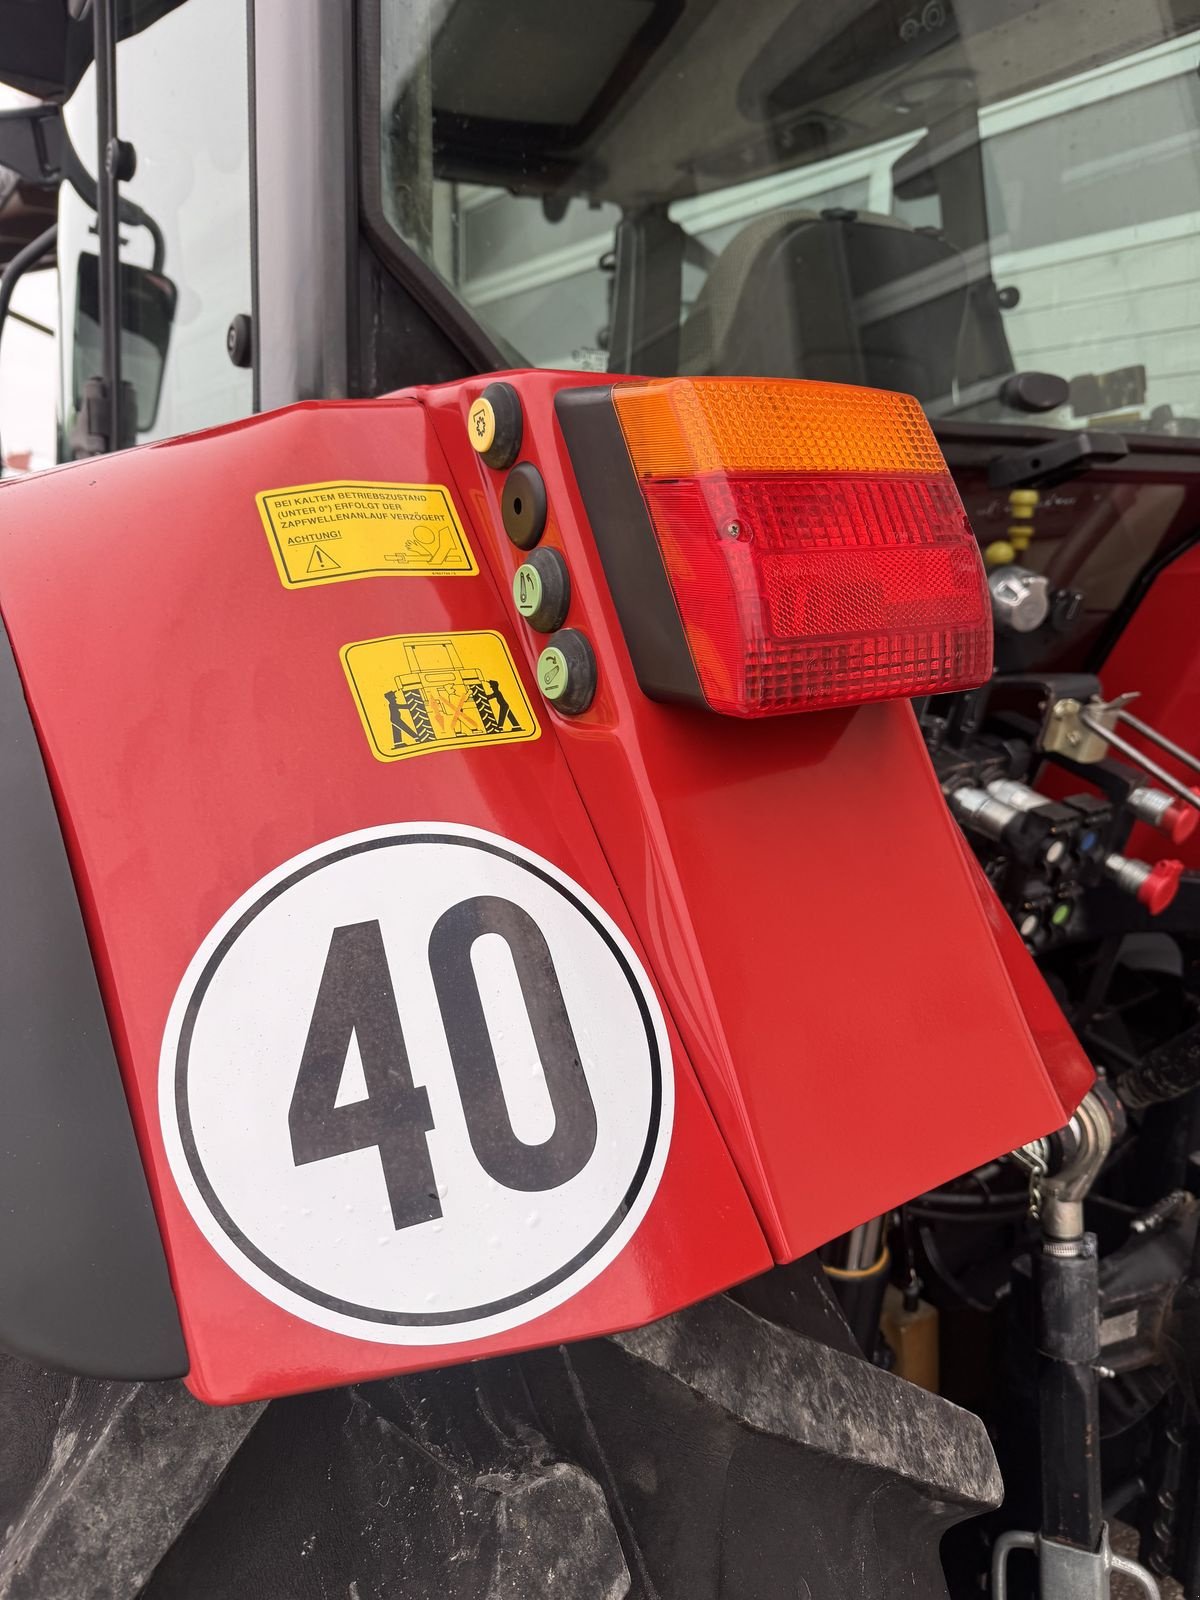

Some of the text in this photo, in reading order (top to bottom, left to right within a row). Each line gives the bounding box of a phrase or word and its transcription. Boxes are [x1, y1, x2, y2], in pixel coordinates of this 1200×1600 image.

[274, 491, 427, 509] BEI KALTEM BETRIEBSZUSTAND
[277, 507, 318, 519] (UNTER
[334, 502, 380, 512] ERFOLGT
[382, 502, 402, 511] DER
[281, 512, 445, 529] ZAPFWELLENANLAUF VERZÖGERT
[287, 530, 342, 544] ACHTUNG!
[288, 895, 598, 1231] 40
